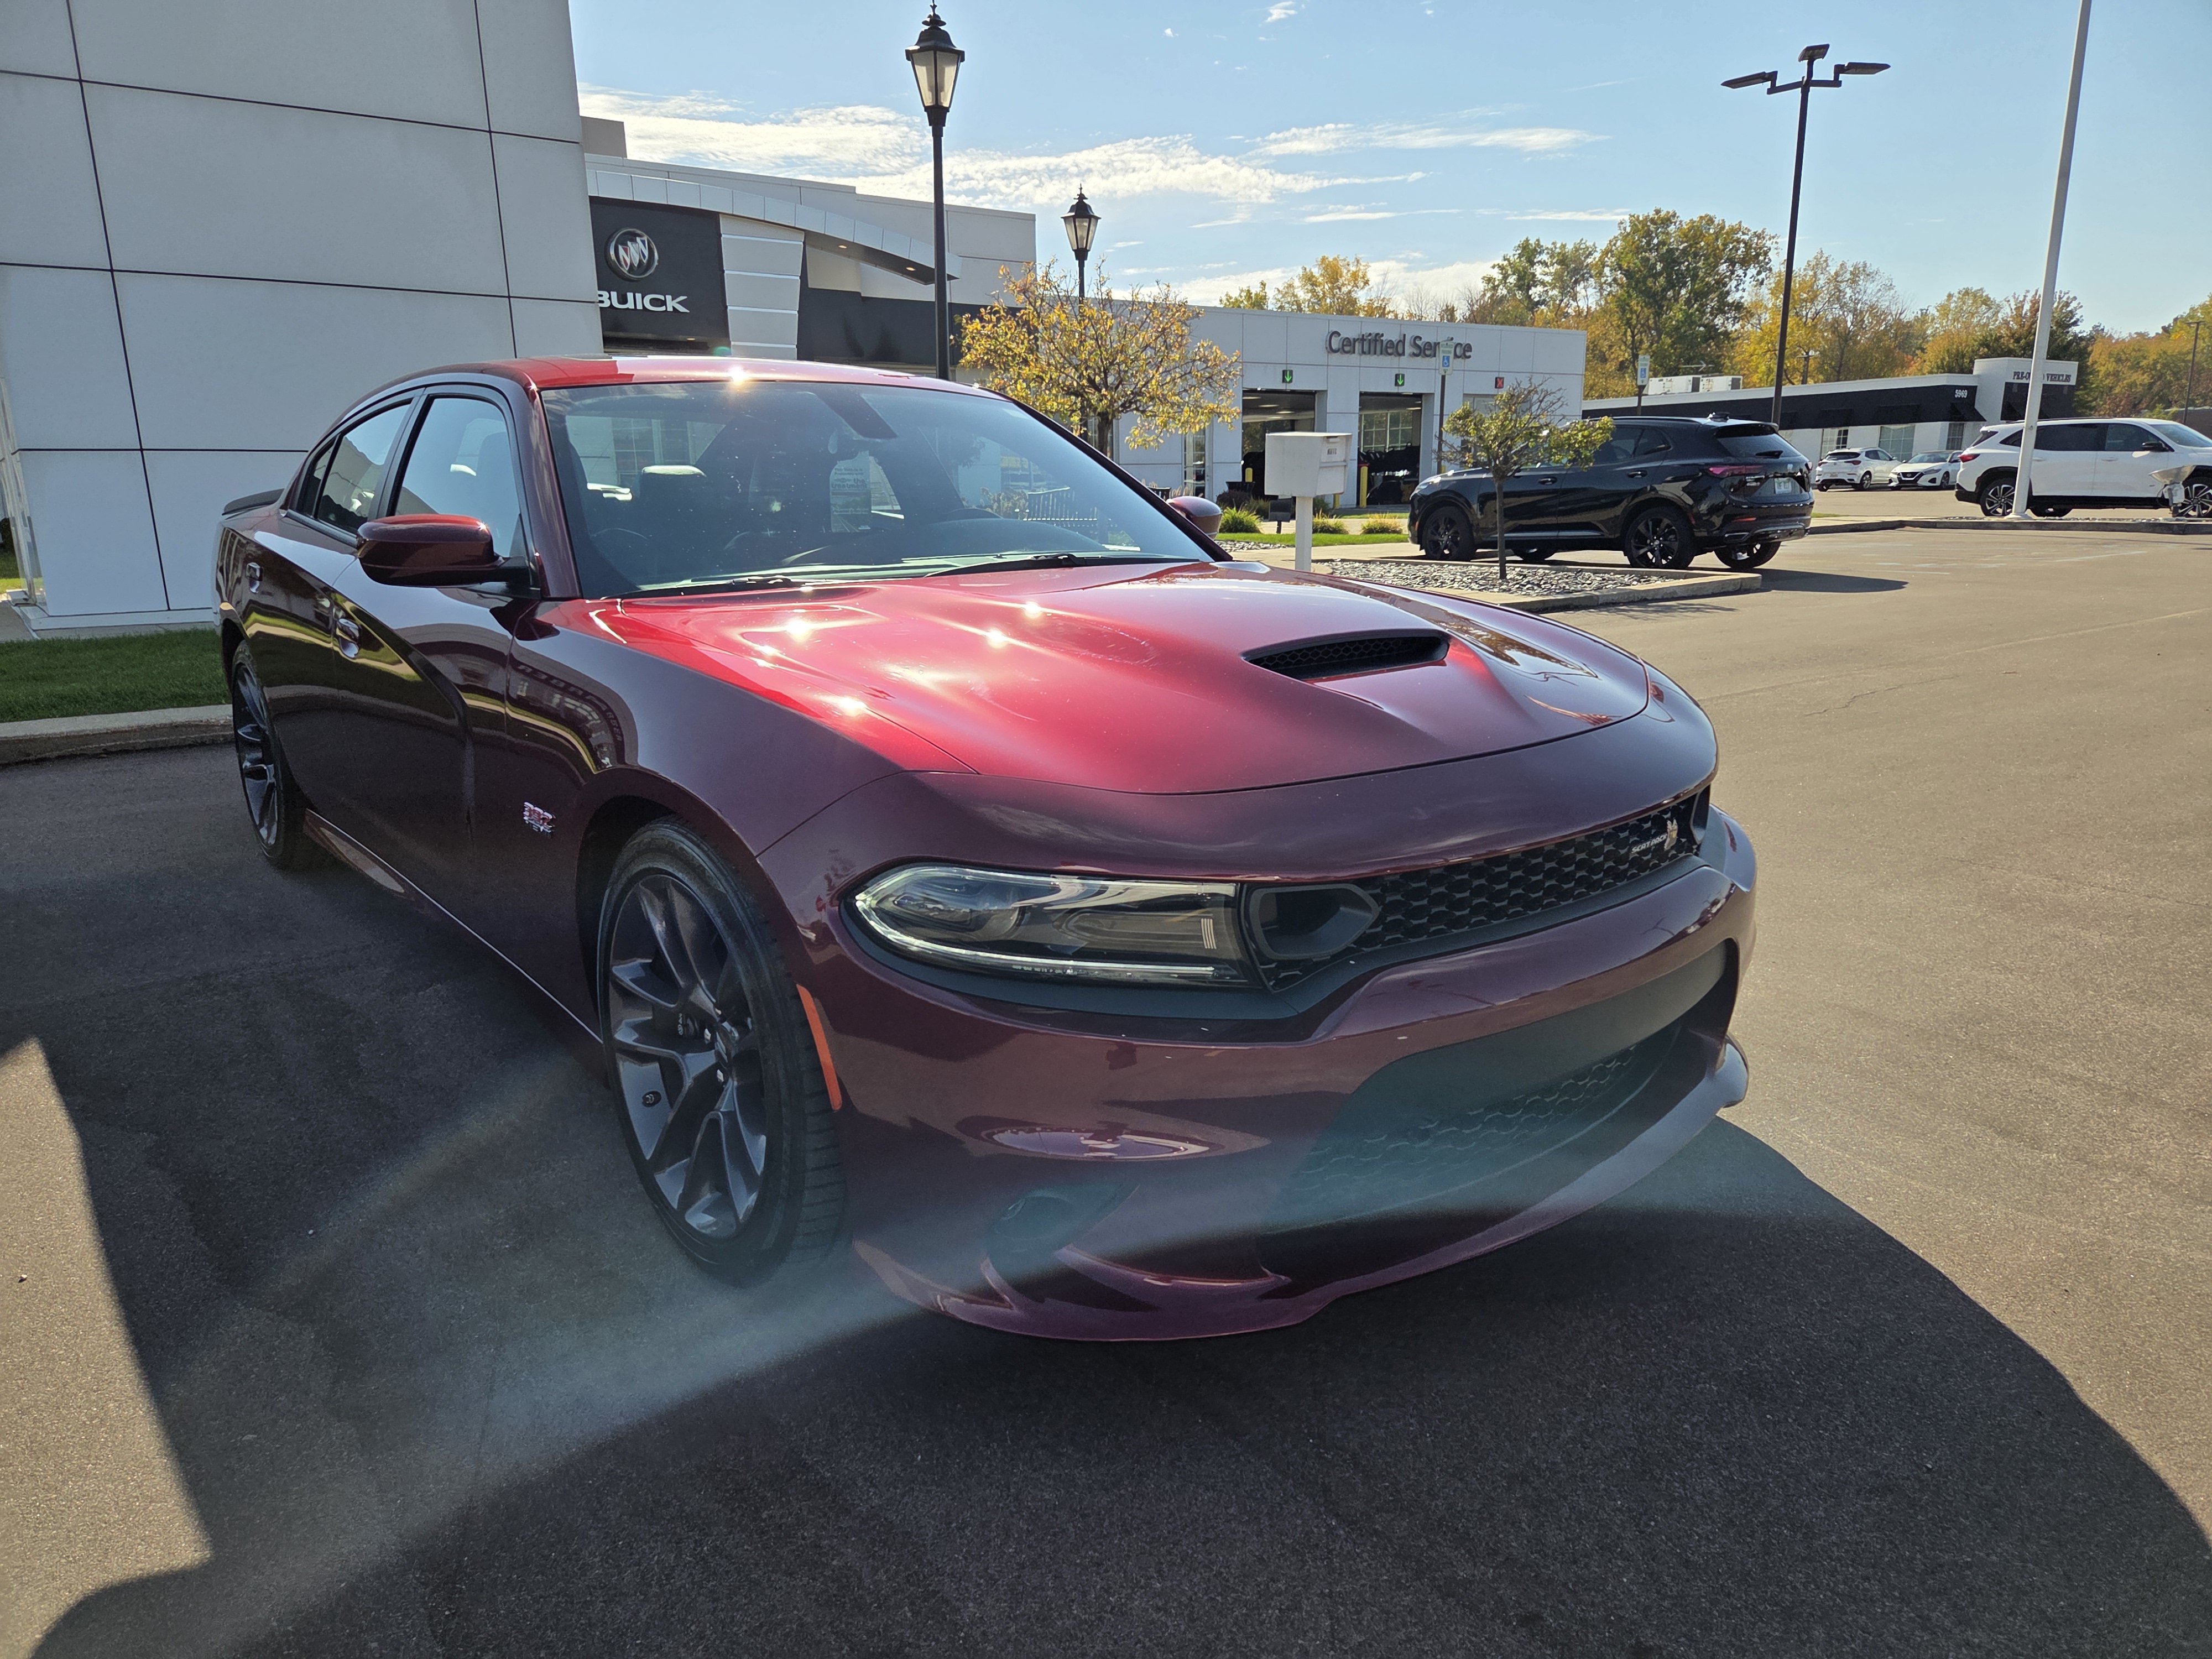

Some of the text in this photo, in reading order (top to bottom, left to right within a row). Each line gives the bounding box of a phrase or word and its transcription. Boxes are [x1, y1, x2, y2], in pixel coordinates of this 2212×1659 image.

[597, 290, 690, 313] BUICK
[1327, 330, 1473, 359] Certified Serce
[2046, 373, 2072, 383] VEHICLES
